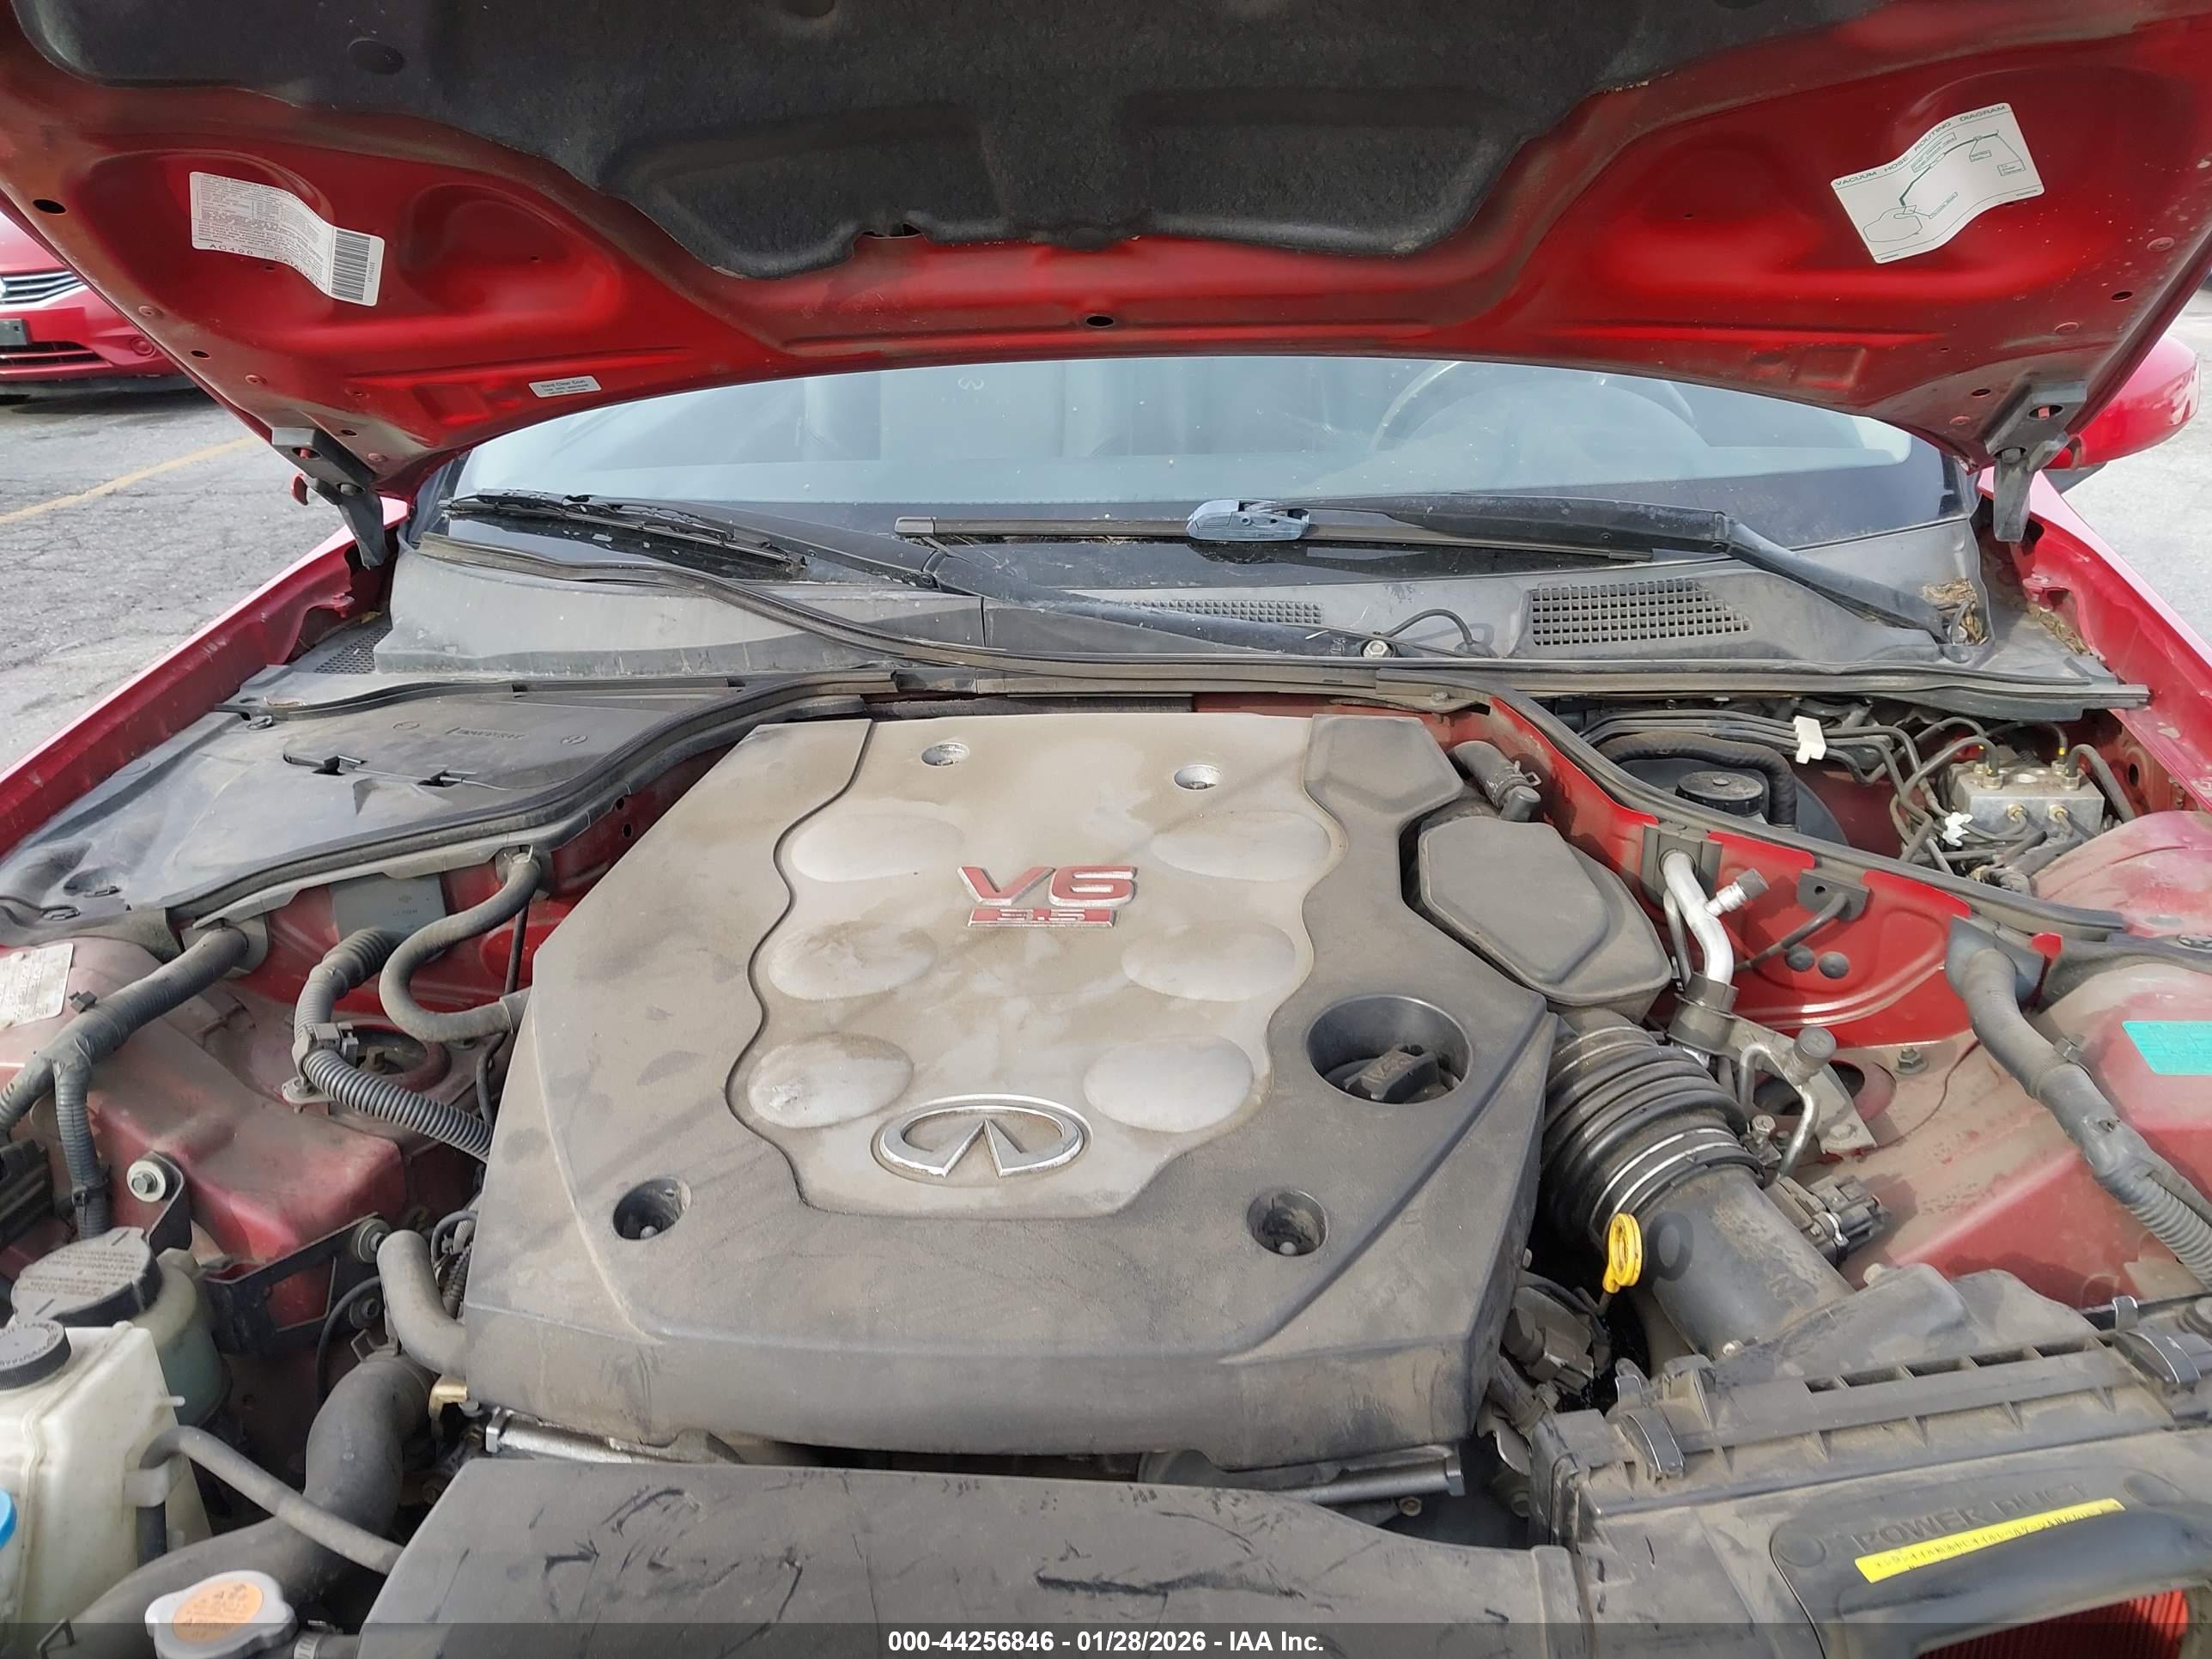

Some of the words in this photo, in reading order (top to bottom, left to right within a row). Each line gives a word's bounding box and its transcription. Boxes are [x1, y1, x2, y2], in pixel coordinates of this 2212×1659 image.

[1835, 171, 1877, 185] VACUUM
[1884, 155, 1910, 173] HOSE
[1914, 121, 1951, 152] ROUTING
[1959, 105, 2006, 123] DIAGRAM
[957, 866, 1138, 907] V6
[1850, 1505, 1991, 1554] POWER
